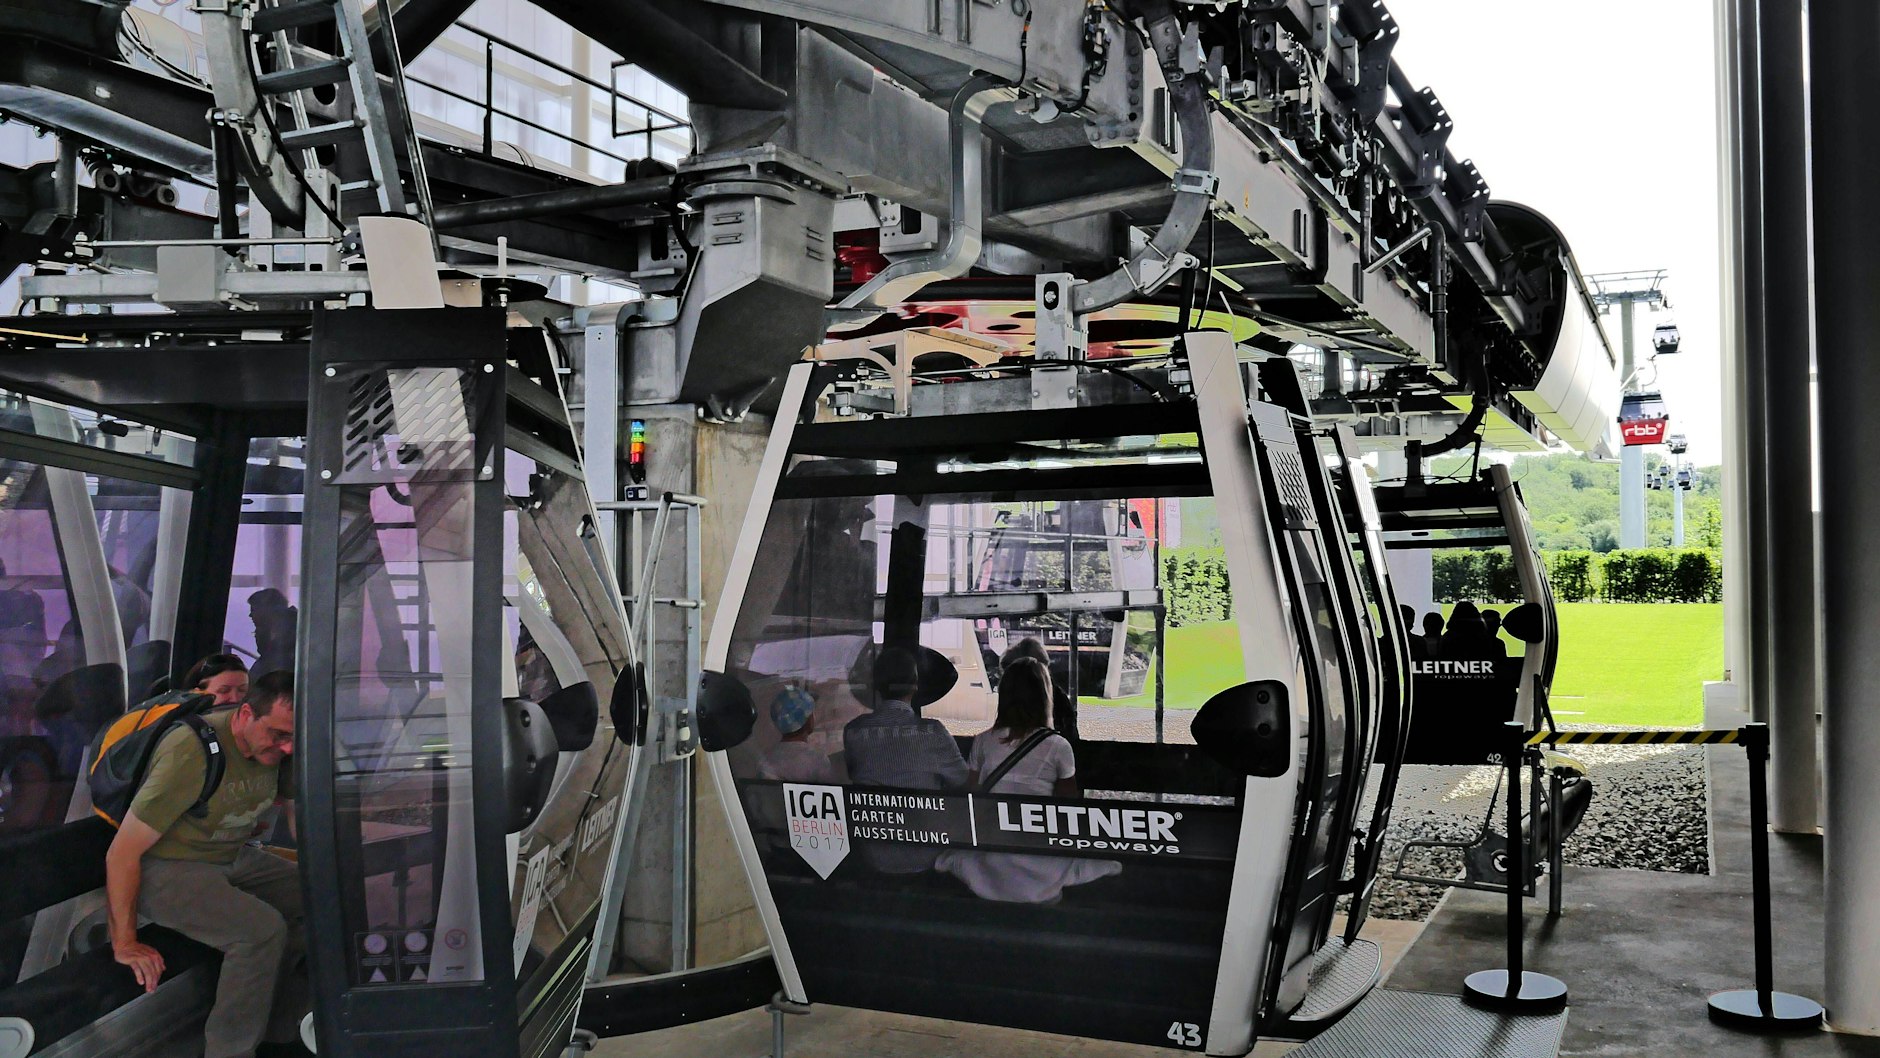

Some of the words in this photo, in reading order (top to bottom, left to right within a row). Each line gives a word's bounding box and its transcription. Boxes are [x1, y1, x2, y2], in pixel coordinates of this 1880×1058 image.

[1624, 424, 1658, 437] rbb
[989, 629, 1006, 639] IGA
[1411, 660, 1494, 674] LEITNER
[1487, 753, 1503, 764] 42
[788, 790, 841, 820] IGA
[849, 792, 946, 811] INTERNATIONALE
[851, 809, 906, 825] GARTEN
[792, 819, 844, 836] BERLIN
[853, 825, 950, 845] AUSSTELLUNG
[794, 834, 845, 851] 2017
[1048, 837, 1181, 855] ropeways
[1166, 1021, 1202, 1047] 43
